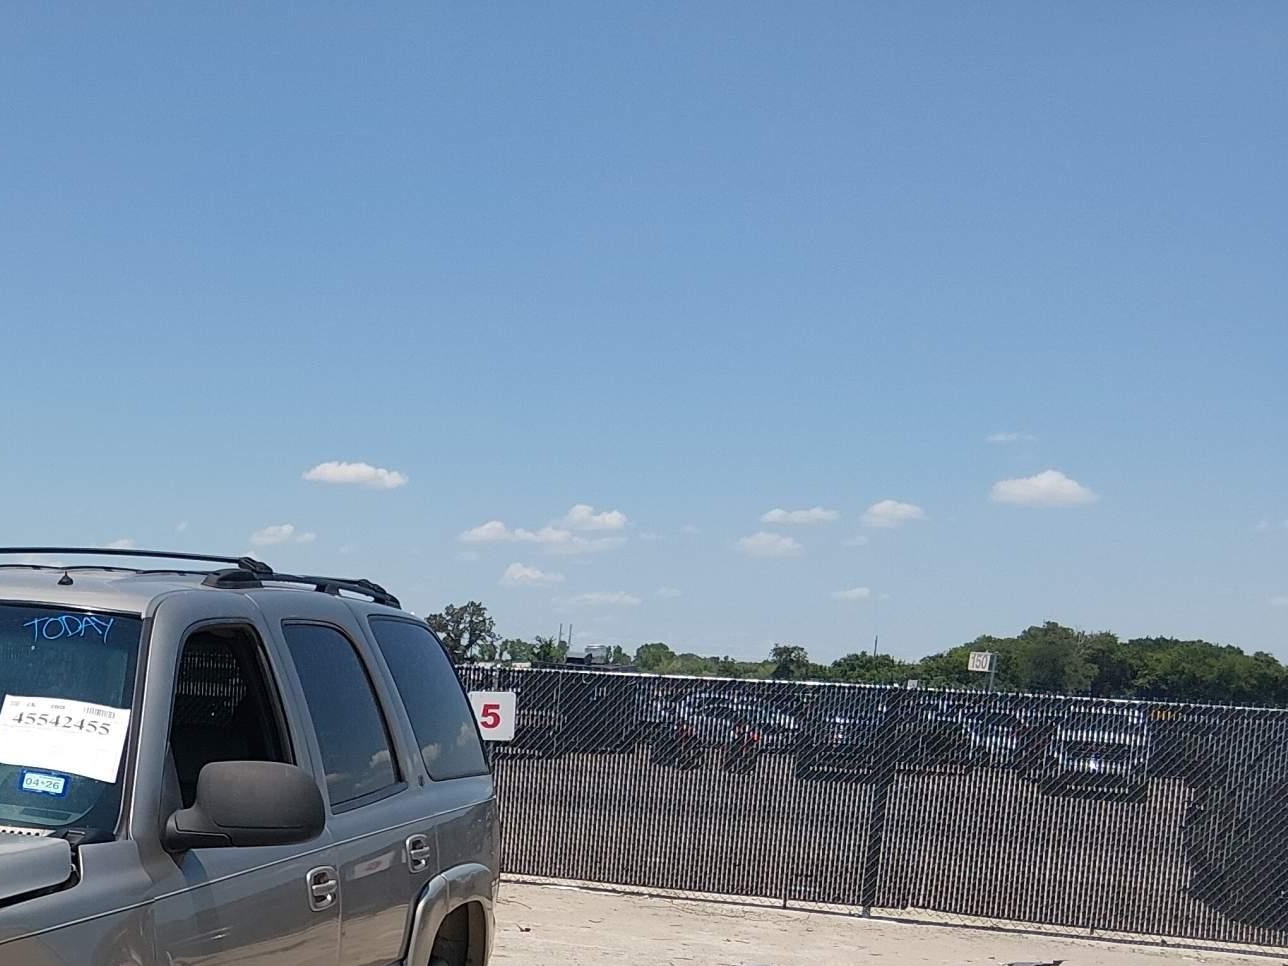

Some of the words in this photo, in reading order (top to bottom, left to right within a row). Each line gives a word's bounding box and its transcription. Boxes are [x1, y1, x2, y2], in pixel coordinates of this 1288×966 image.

[24, 615, 114, 644] TODAY
[971, 653, 988, 669] 150
[12, 711, 112, 736] 45542455
[480, 704, 501, 729] 5
